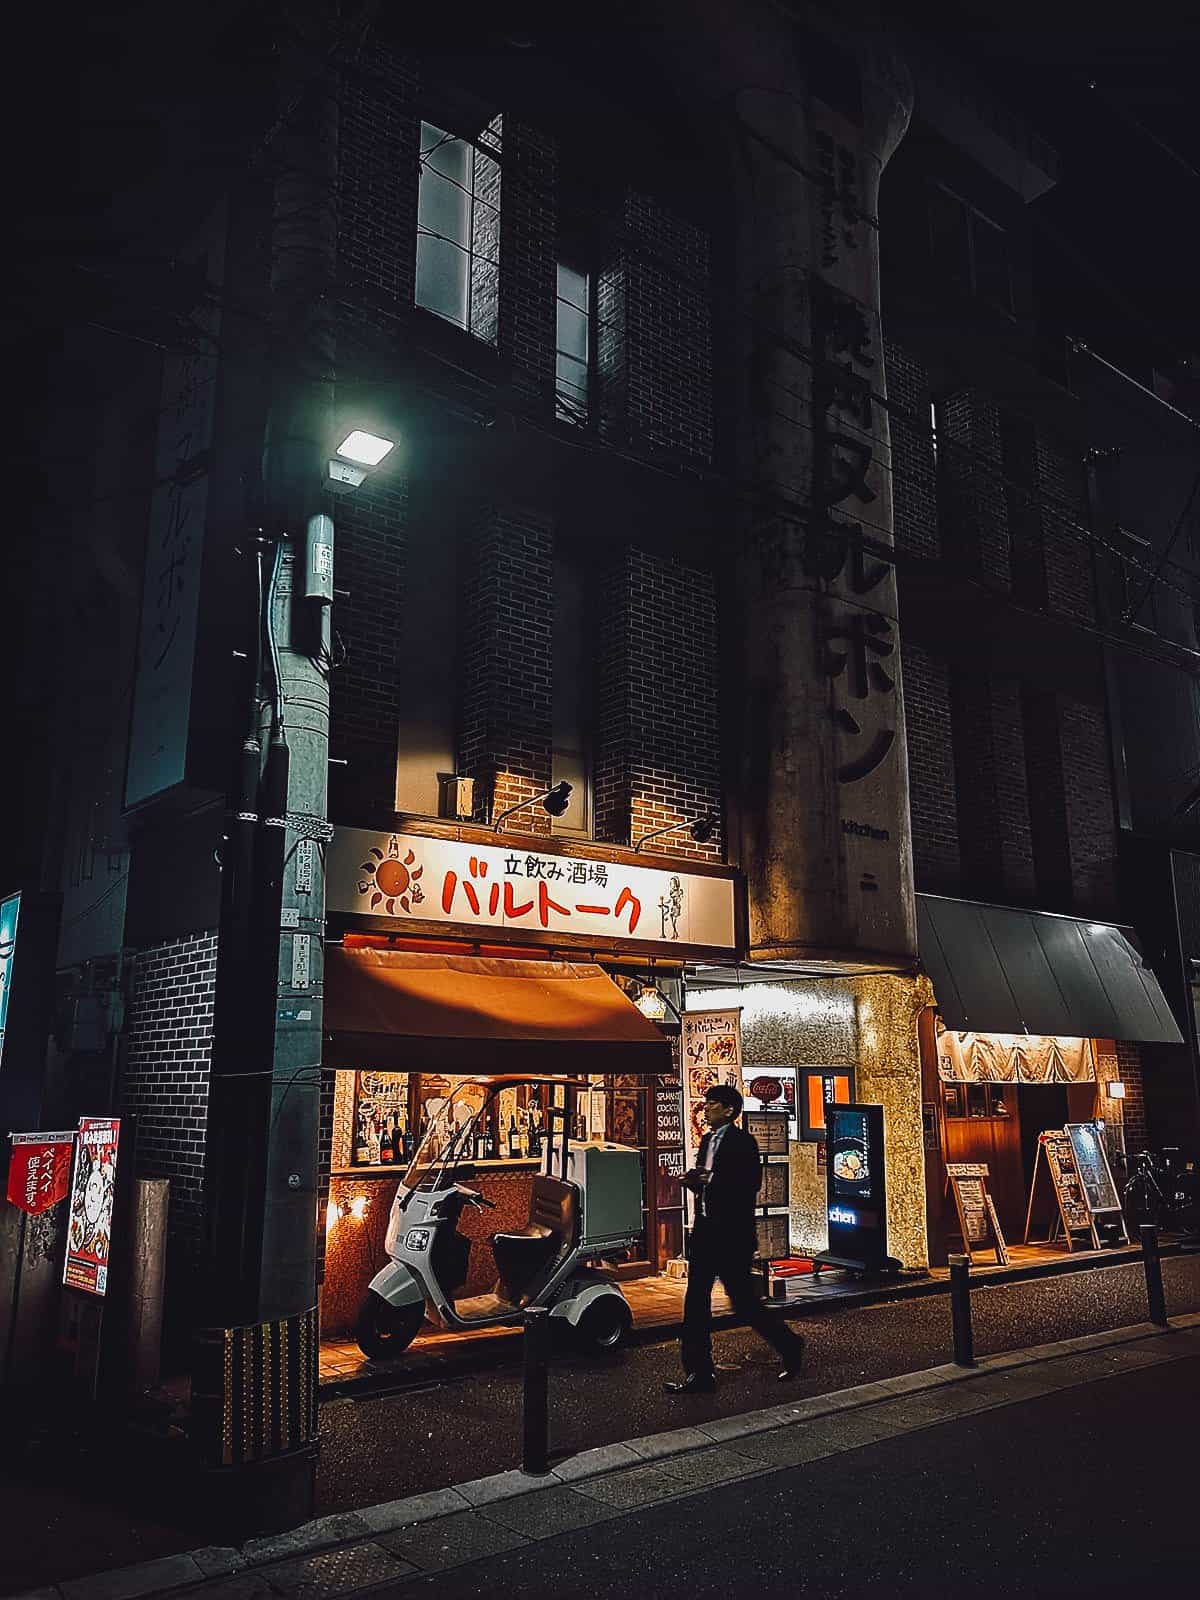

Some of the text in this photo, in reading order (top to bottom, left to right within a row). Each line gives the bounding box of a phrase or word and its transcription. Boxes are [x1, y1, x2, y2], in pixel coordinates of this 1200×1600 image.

[841, 819, 890, 842] kitchen
[503, 853, 609, 888] 立飲み酒場
[442, 856, 642, 934] バルトーク
[40, 1147, 56, 1192] ペイペイ
[658, 1152, 683, 1167] FRUIT
